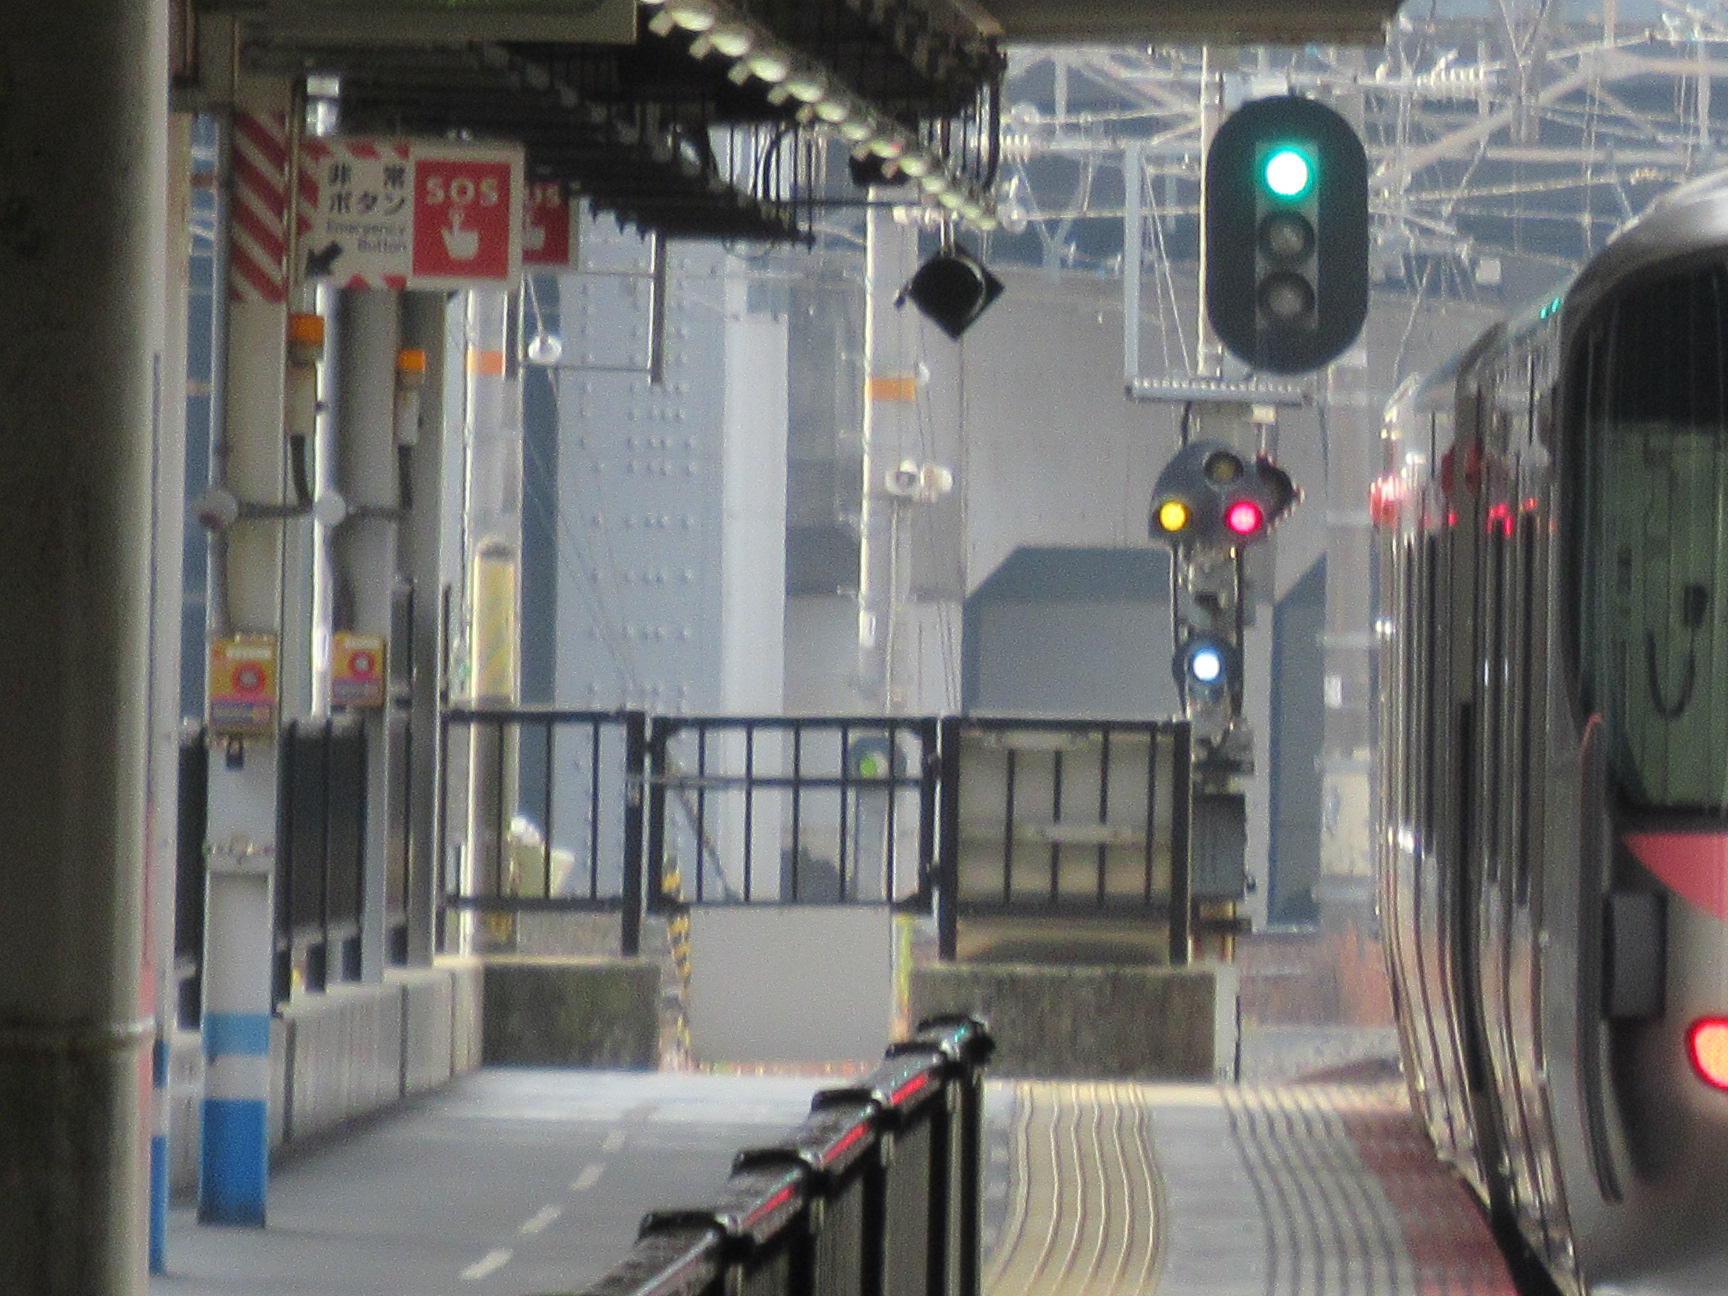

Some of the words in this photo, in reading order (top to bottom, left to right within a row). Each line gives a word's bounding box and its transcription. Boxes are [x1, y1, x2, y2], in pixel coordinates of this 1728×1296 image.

[328, 162, 405, 188] 非常
[328, 189, 405, 215] ボタン
[426, 177, 500, 206] SOS
[357, 238, 406, 253] Button
